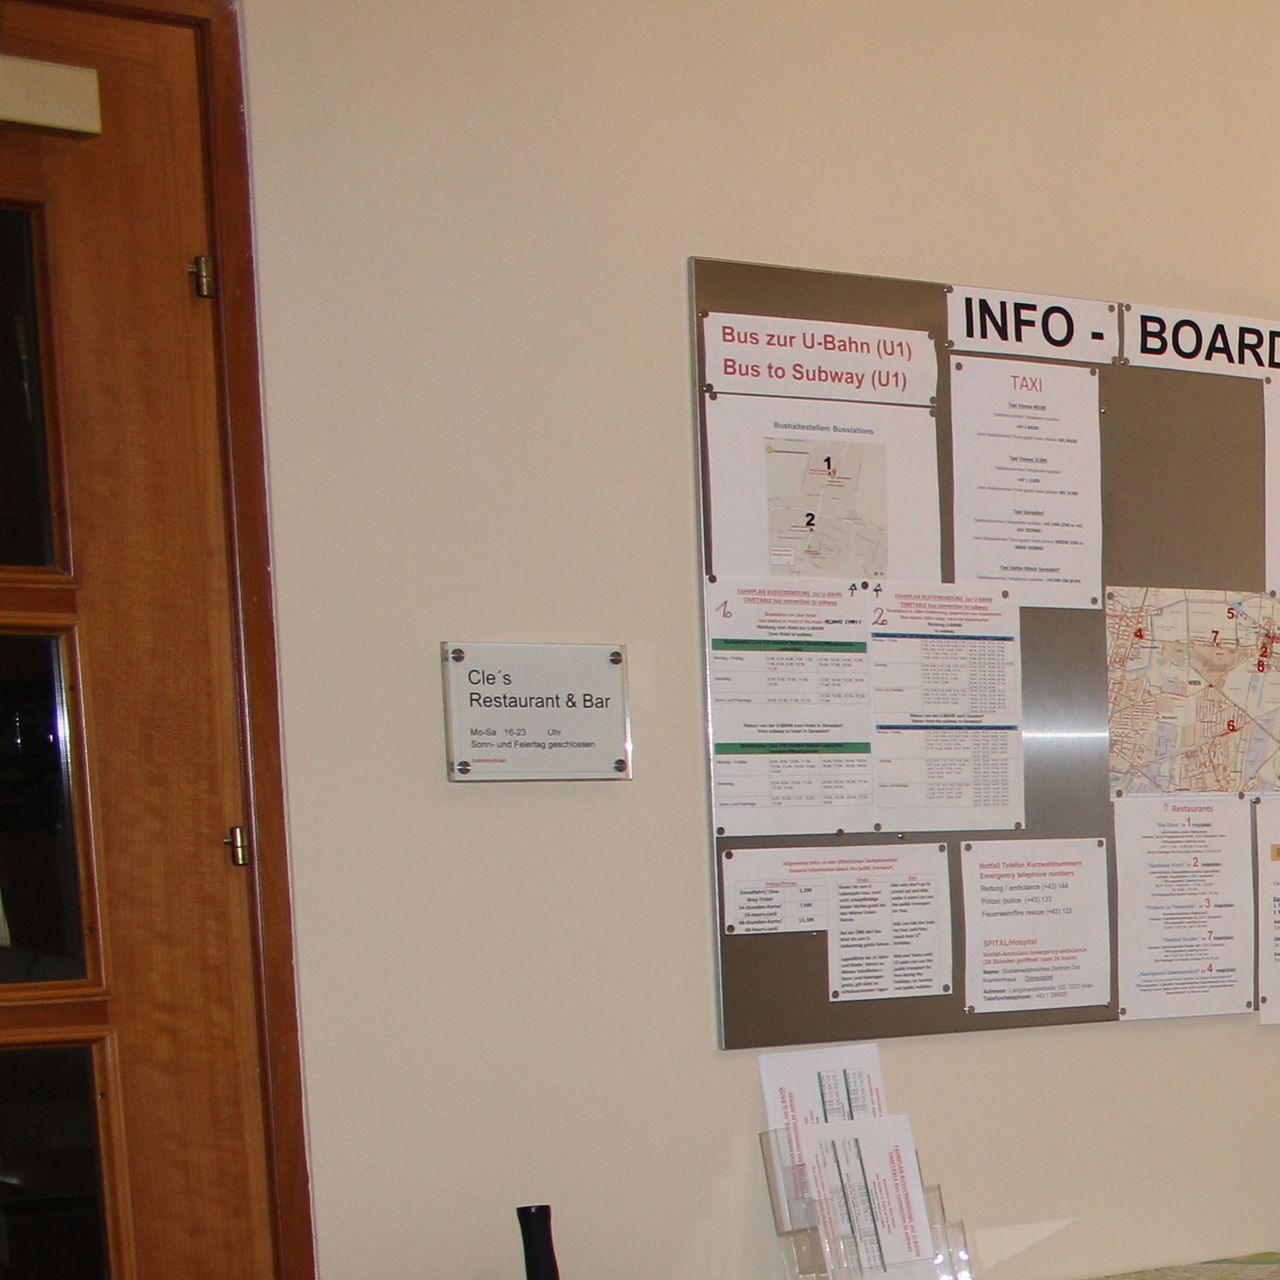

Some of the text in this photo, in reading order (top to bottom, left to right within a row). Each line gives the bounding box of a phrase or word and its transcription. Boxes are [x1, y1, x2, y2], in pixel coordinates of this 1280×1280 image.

[964, 297, 1075, 347] INFO
[721, 326, 912, 361] Bus zur U-Bahn (U1)
[723, 358, 907, 392] Bus to Subway (U1)
[1010, 375, 1042, 392] TAXI
[823, 456, 832, 469] 1
[805, 512, 816, 526] 2
[1226, 608, 1235, 619] 5
[1134, 628, 1144, 639] 4
[1212, 630, 1220, 642] 7
[1258, 646, 1268, 658] 2
[1257, 660, 1265, 672] 8
[469, 692, 611, 709] Restaurant & Bar
[470, 728, 497, 736] Mo-Sa
[548, 728, 562, 736] Uhr
[1226, 720, 1236, 732] 6
[513, 741, 546, 750] Feiertag
[548, 740, 596, 750] geschlossen
[1172, 804, 1214, 813] Restaurants
[1186, 817, 1192, 827] 1
[1192, 856, 1199, 868] 2
[1204, 898, 1211, 908] 3
[1207, 931, 1214, 940] 7
[1206, 963, 1214, 973] 4
